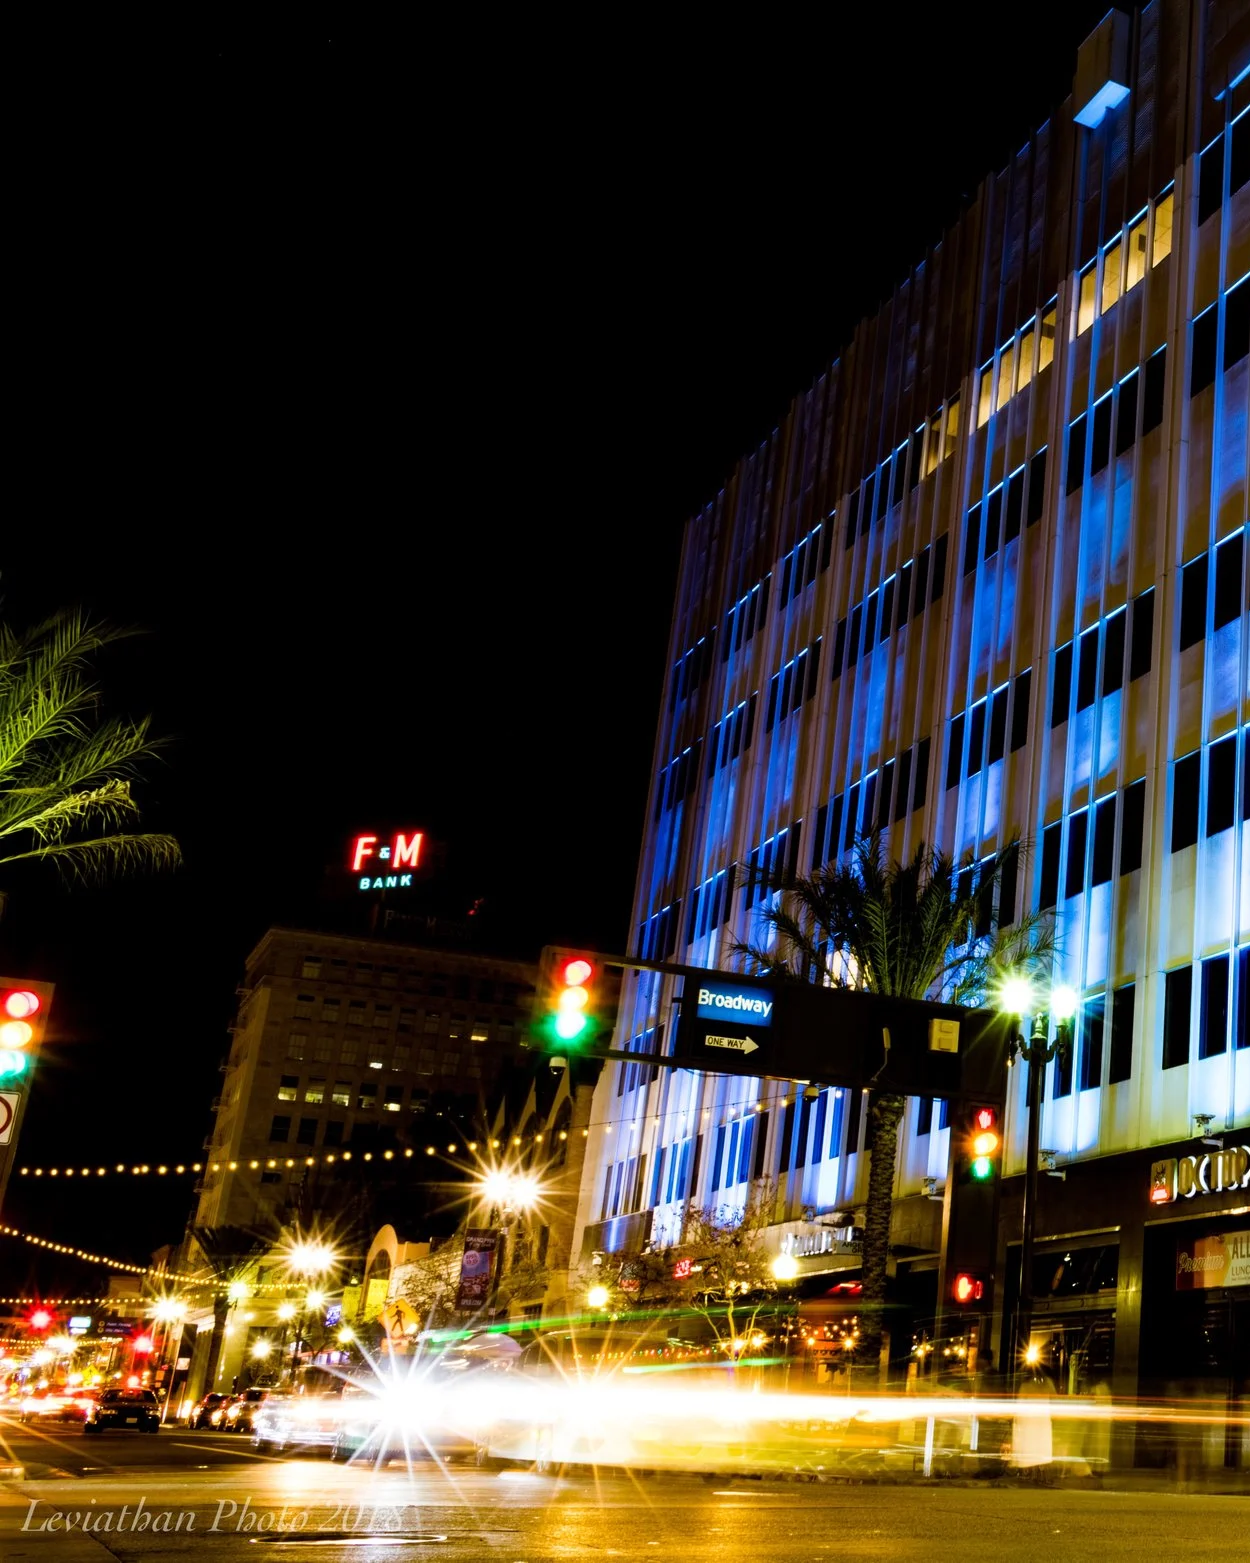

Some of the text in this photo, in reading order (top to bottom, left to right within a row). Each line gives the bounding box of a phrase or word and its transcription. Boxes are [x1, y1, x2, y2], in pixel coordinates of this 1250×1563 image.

[360, 874, 412, 890] BANK
[698, 988, 773, 1018] Broadway
[707, 1037, 745, 1049] ONE WAY
